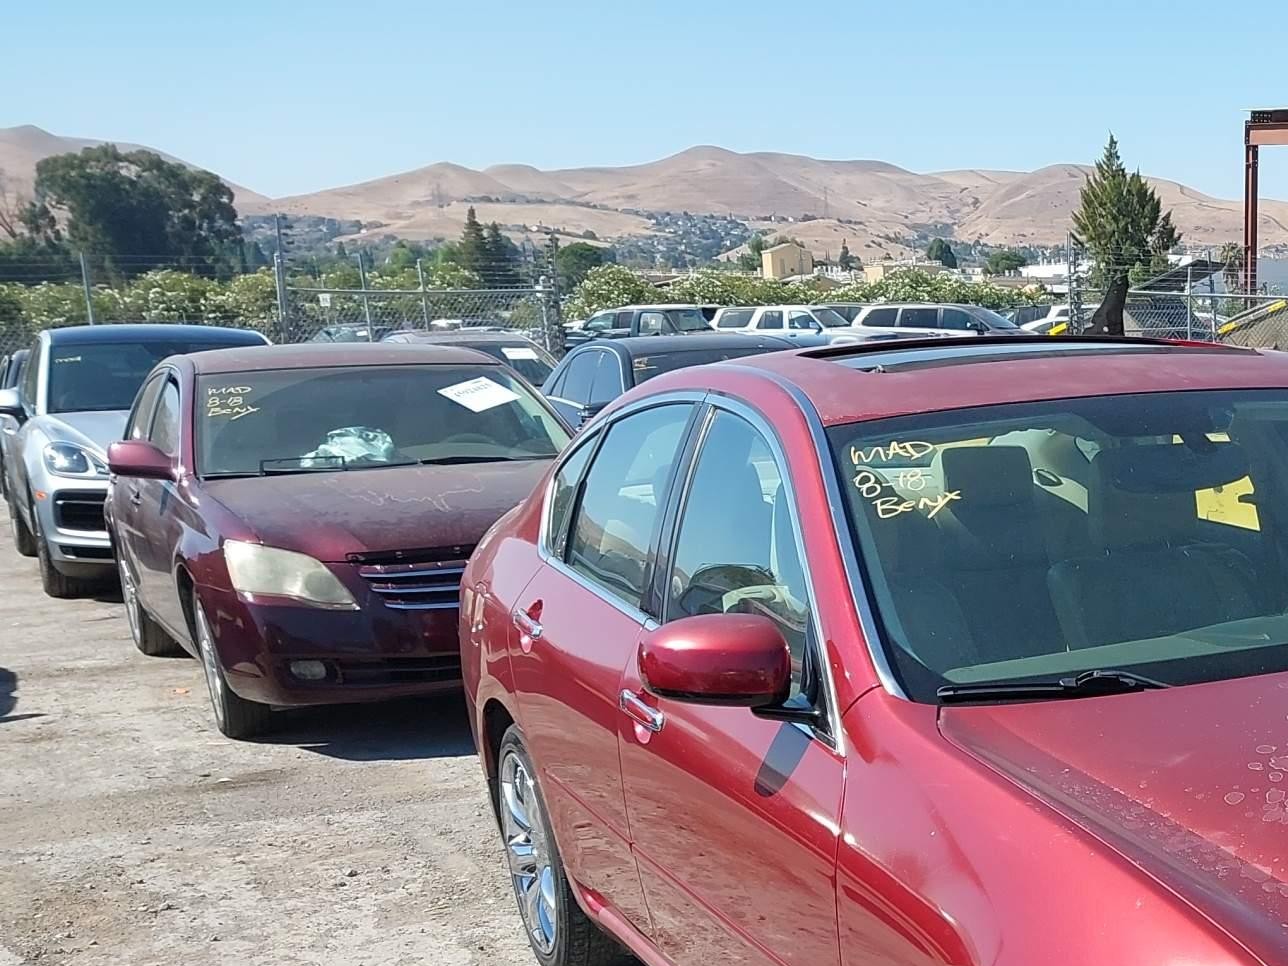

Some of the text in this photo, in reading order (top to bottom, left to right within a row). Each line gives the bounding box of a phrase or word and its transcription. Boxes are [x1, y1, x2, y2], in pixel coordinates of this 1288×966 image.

[207, 386, 253, 395] MAD
[850, 440, 934, 465] MAD
[852, 469, 926, 498] 8-18
